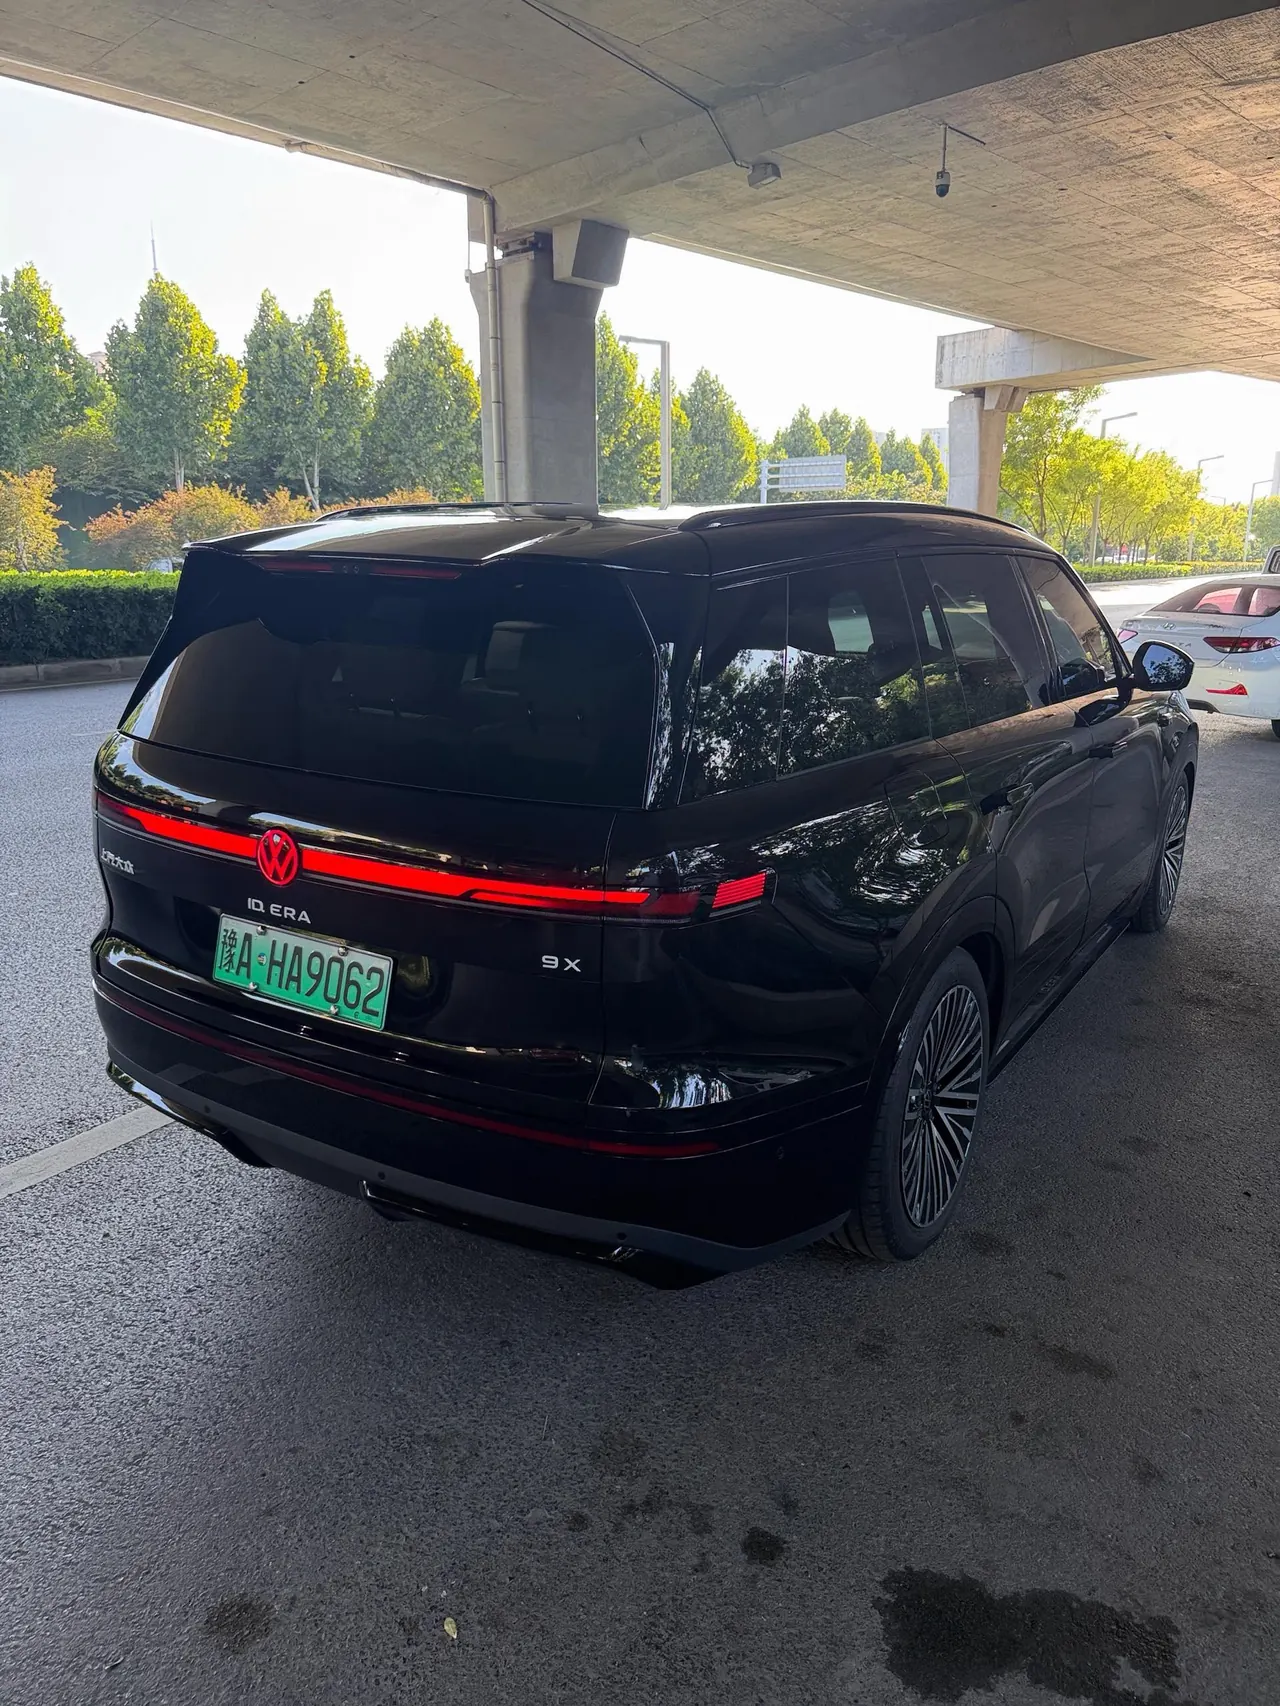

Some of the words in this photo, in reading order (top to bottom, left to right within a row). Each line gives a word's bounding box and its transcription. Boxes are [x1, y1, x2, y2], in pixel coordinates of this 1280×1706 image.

[101, 847, 135, 875] 上汽大众
[269, 903, 312, 924] ERA
